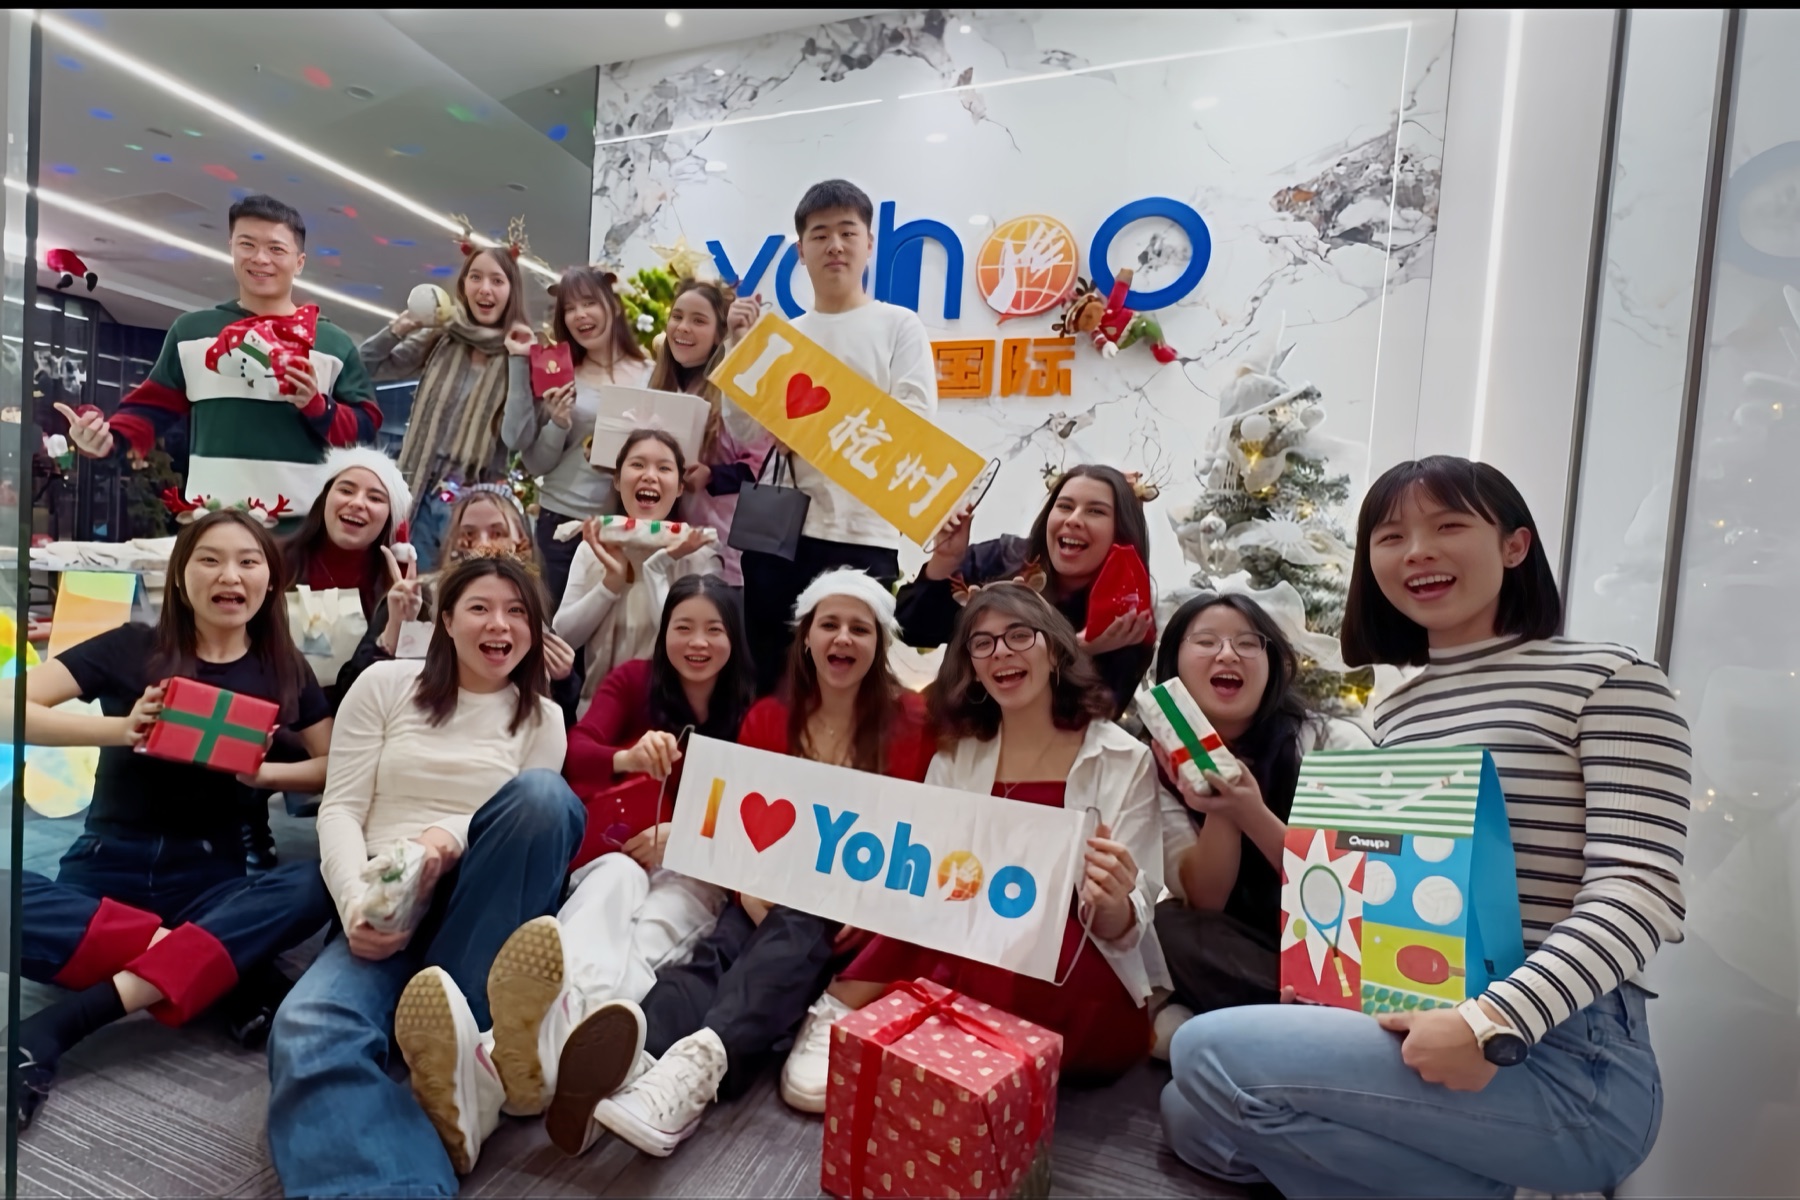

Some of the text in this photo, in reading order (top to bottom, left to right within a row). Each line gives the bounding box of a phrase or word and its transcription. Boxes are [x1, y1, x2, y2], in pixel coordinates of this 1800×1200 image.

[733, 332, 958, 518] I 杭州
[930, 337, 1076, 398] 国际
[700, 778, 1037, 919] I Yohoo
